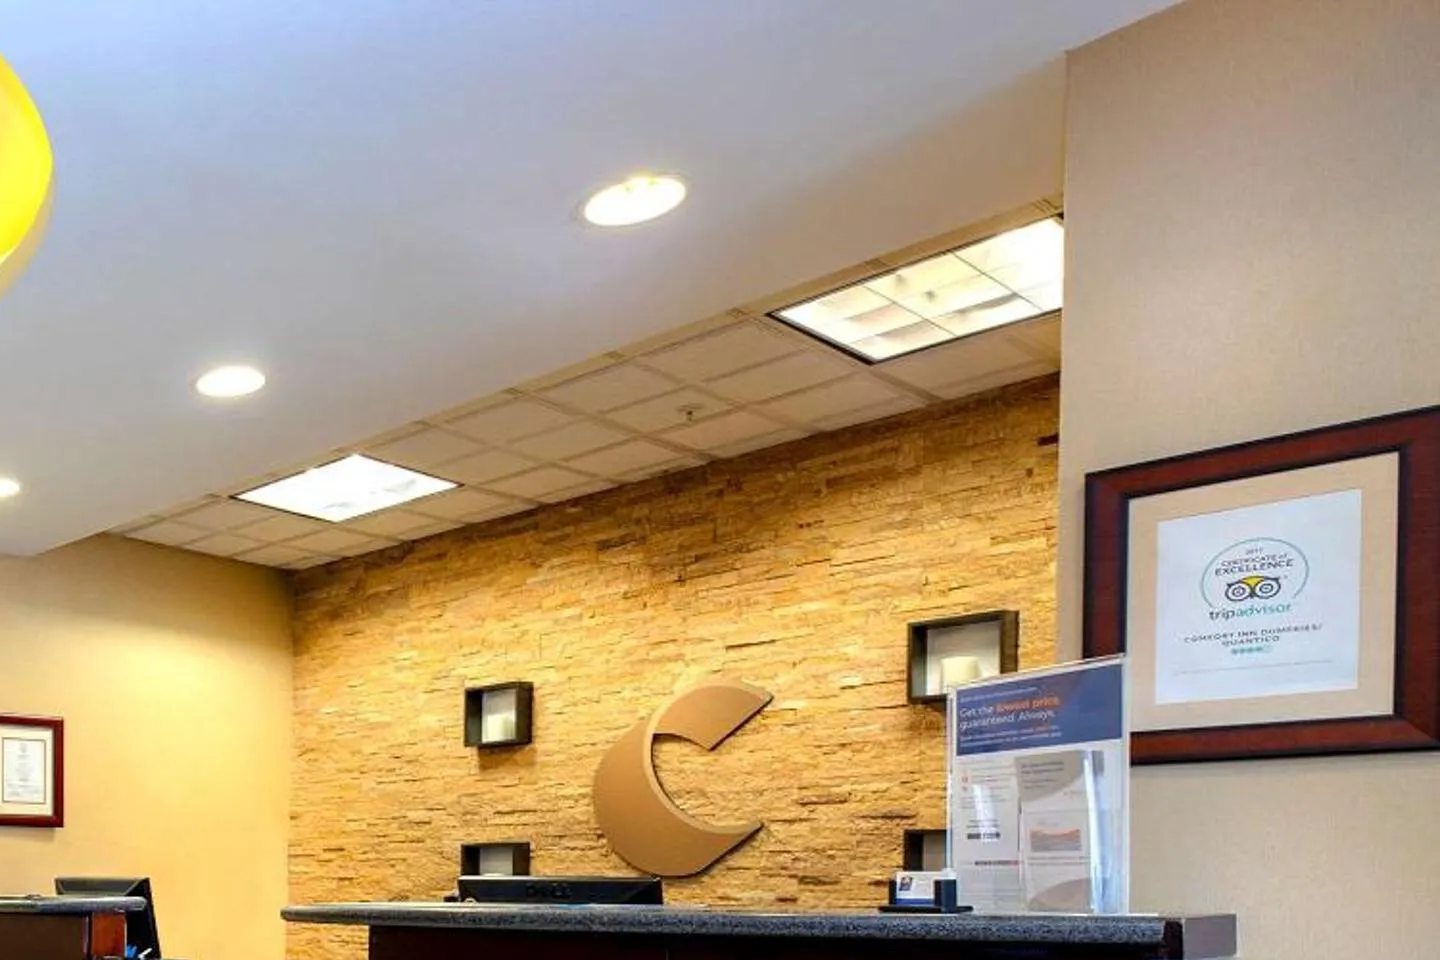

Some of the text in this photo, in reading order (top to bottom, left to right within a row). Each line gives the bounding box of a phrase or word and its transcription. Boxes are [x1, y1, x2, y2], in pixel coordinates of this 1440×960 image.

[1214, 558, 1295, 577] EXCELLENCE
[1220, 553, 1278, 567] CERTIFICATE
[1208, 602, 1293, 621] tripadvisor
